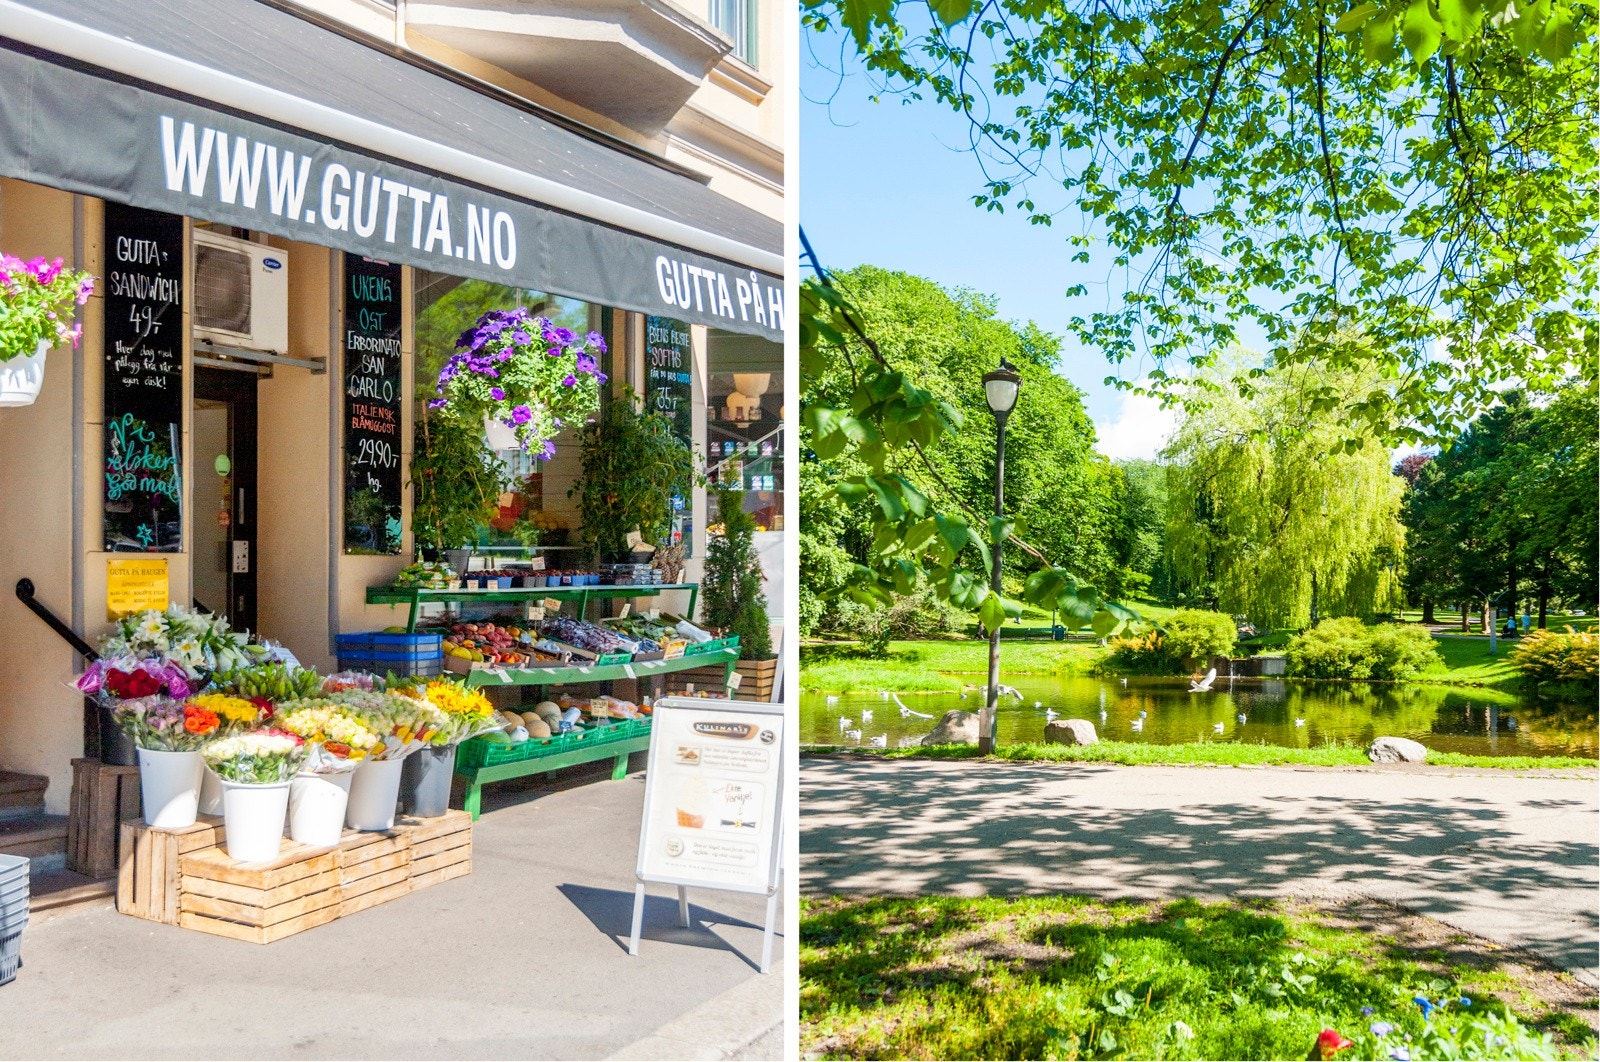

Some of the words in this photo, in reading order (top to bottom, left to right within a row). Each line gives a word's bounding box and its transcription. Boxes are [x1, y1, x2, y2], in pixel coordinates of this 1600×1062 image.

[160, 115, 516, 270] WWW.GUTTA.NO
[352, 273, 392, 302] UKENS
[656, 255, 735, 319] GUTTA
[736, 270, 767, 327] PÅ
[360, 307, 387, 331] OST
[140, 344, 155, 363] dag
[348, 330, 401, 358] ERBORINATO
[361, 354, 385, 376] SAN
[350, 375, 393, 403] CARLO
[110, 412, 155, 452] Vi
[110, 568, 130, 576] GUTTA
[132, 566, 140, 576] PÅ
[141, 568, 166, 576] HAUGEN
